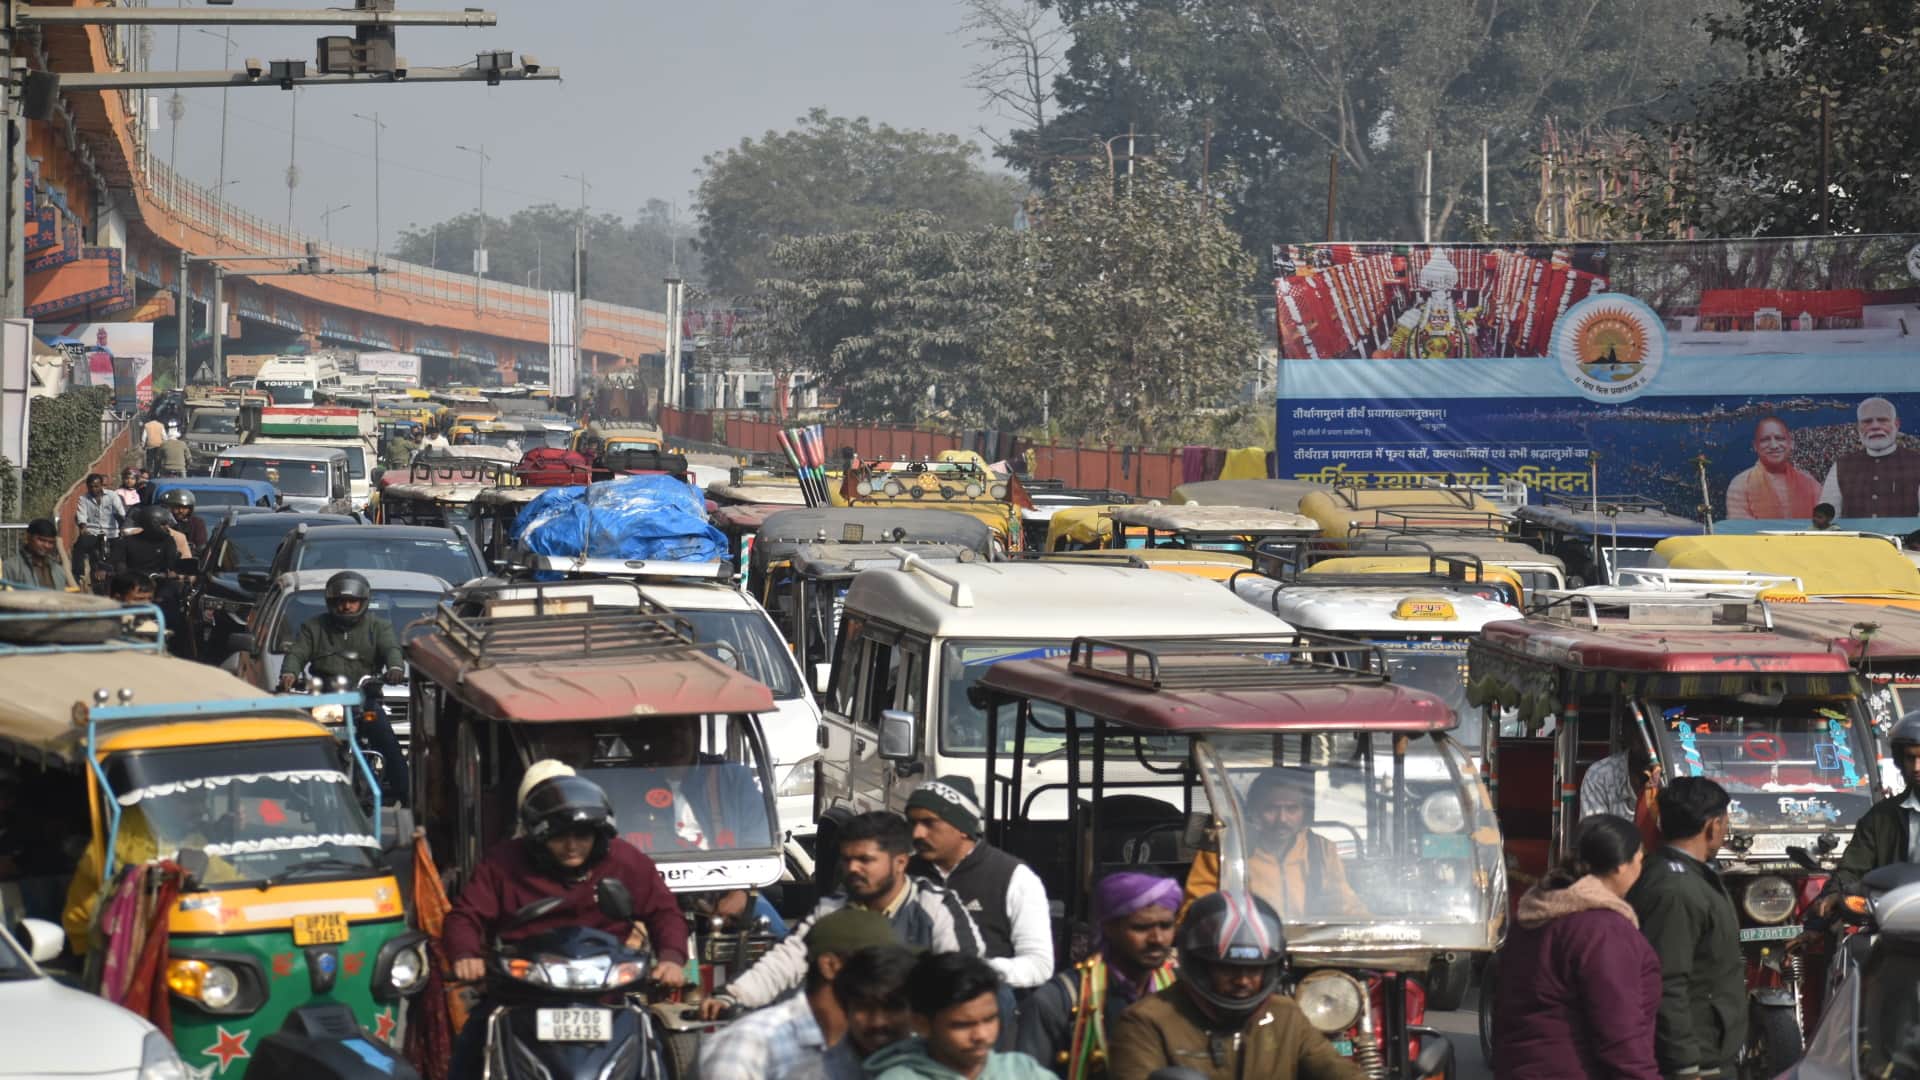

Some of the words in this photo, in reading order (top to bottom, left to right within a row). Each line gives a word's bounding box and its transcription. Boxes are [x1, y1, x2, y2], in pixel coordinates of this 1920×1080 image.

[1331, 449, 1373, 460] प्रयागराज
[1375, 447, 1384, 459] में
[1386, 449, 1405, 462] पूज्य
[1508, 447, 1527, 459] सभी
